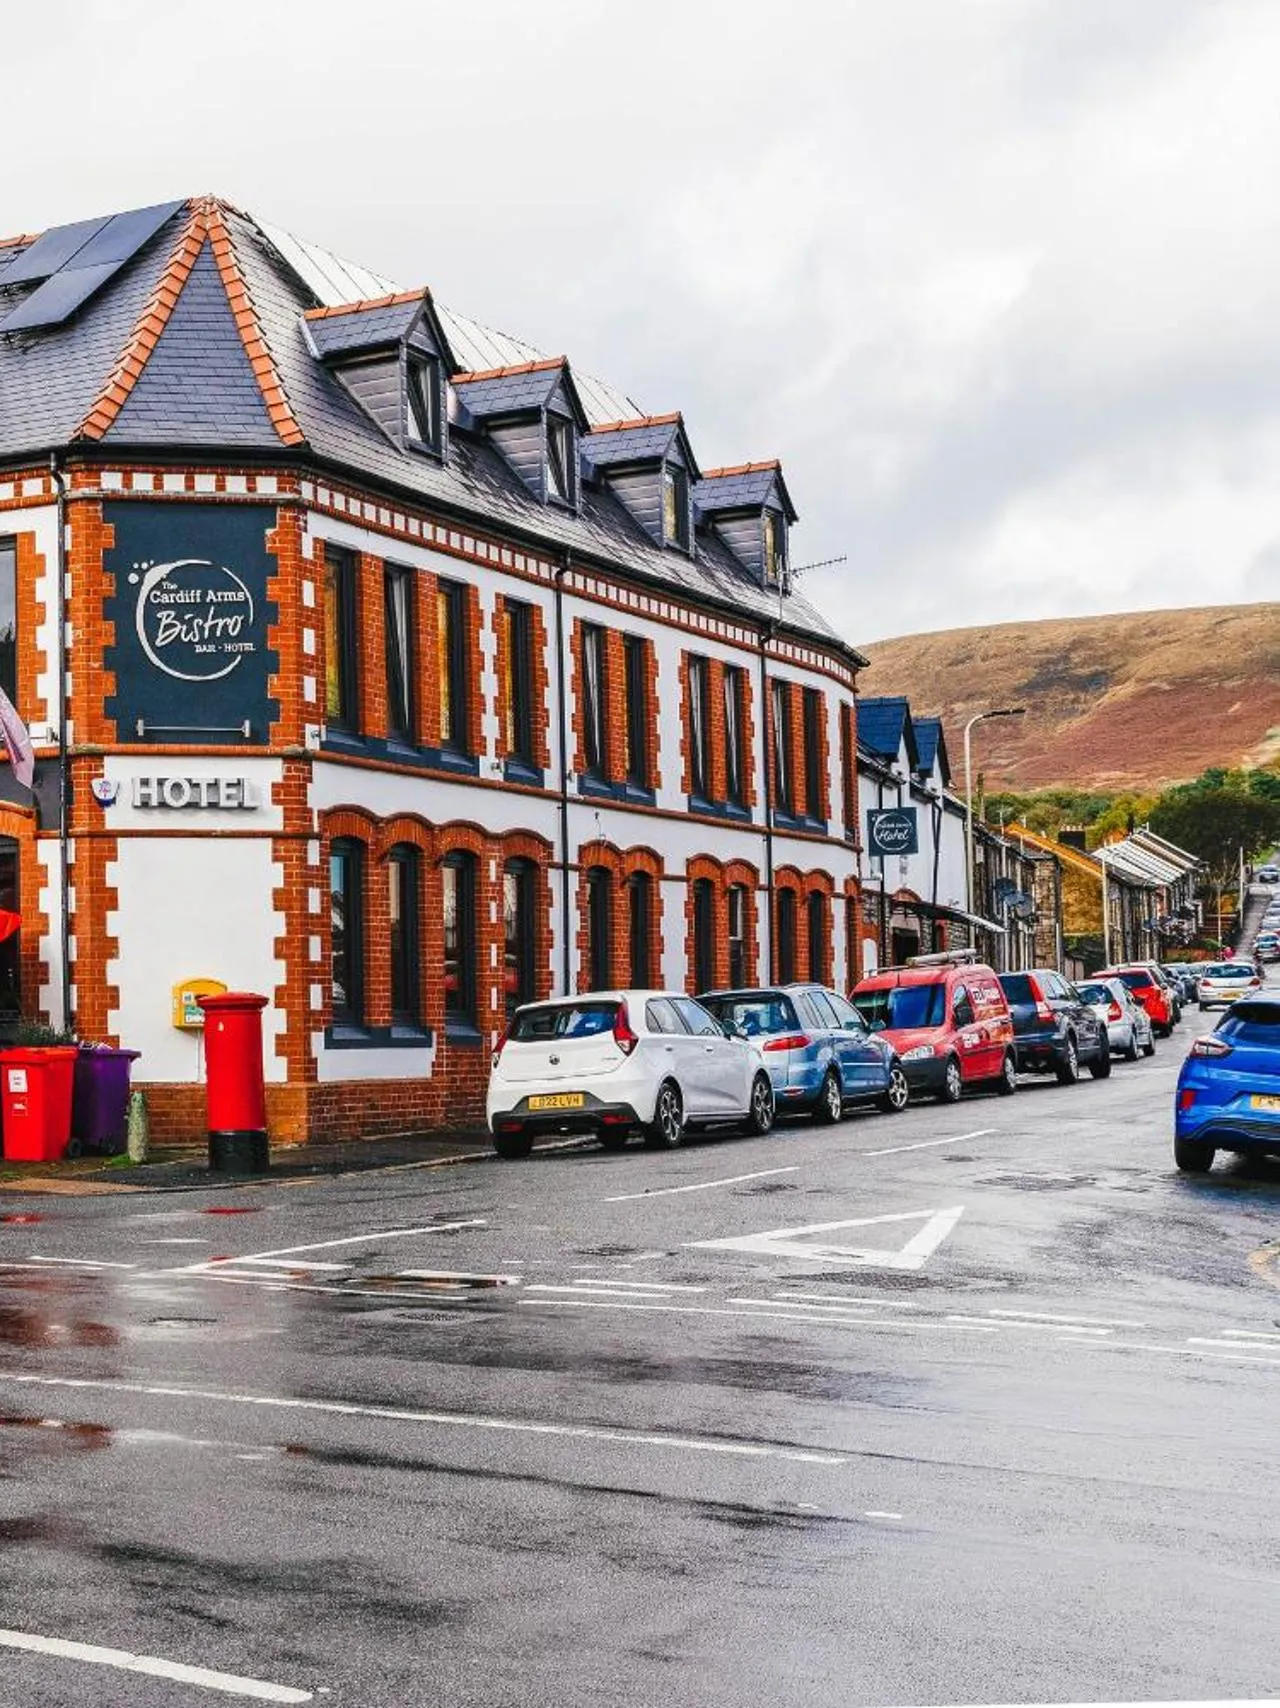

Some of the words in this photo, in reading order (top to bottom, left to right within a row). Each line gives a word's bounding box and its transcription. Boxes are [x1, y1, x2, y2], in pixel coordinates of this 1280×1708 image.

[162, 581, 178, 590] The
[149, 590, 202, 603] Cardiff
[206, 590, 245, 603] Arms
[155, 606, 245, 647] Bistro
[194, 644, 217, 653] BAR
[224, 643, 256, 653] HOTEL
[132, 777, 261, 811] HOTEL
